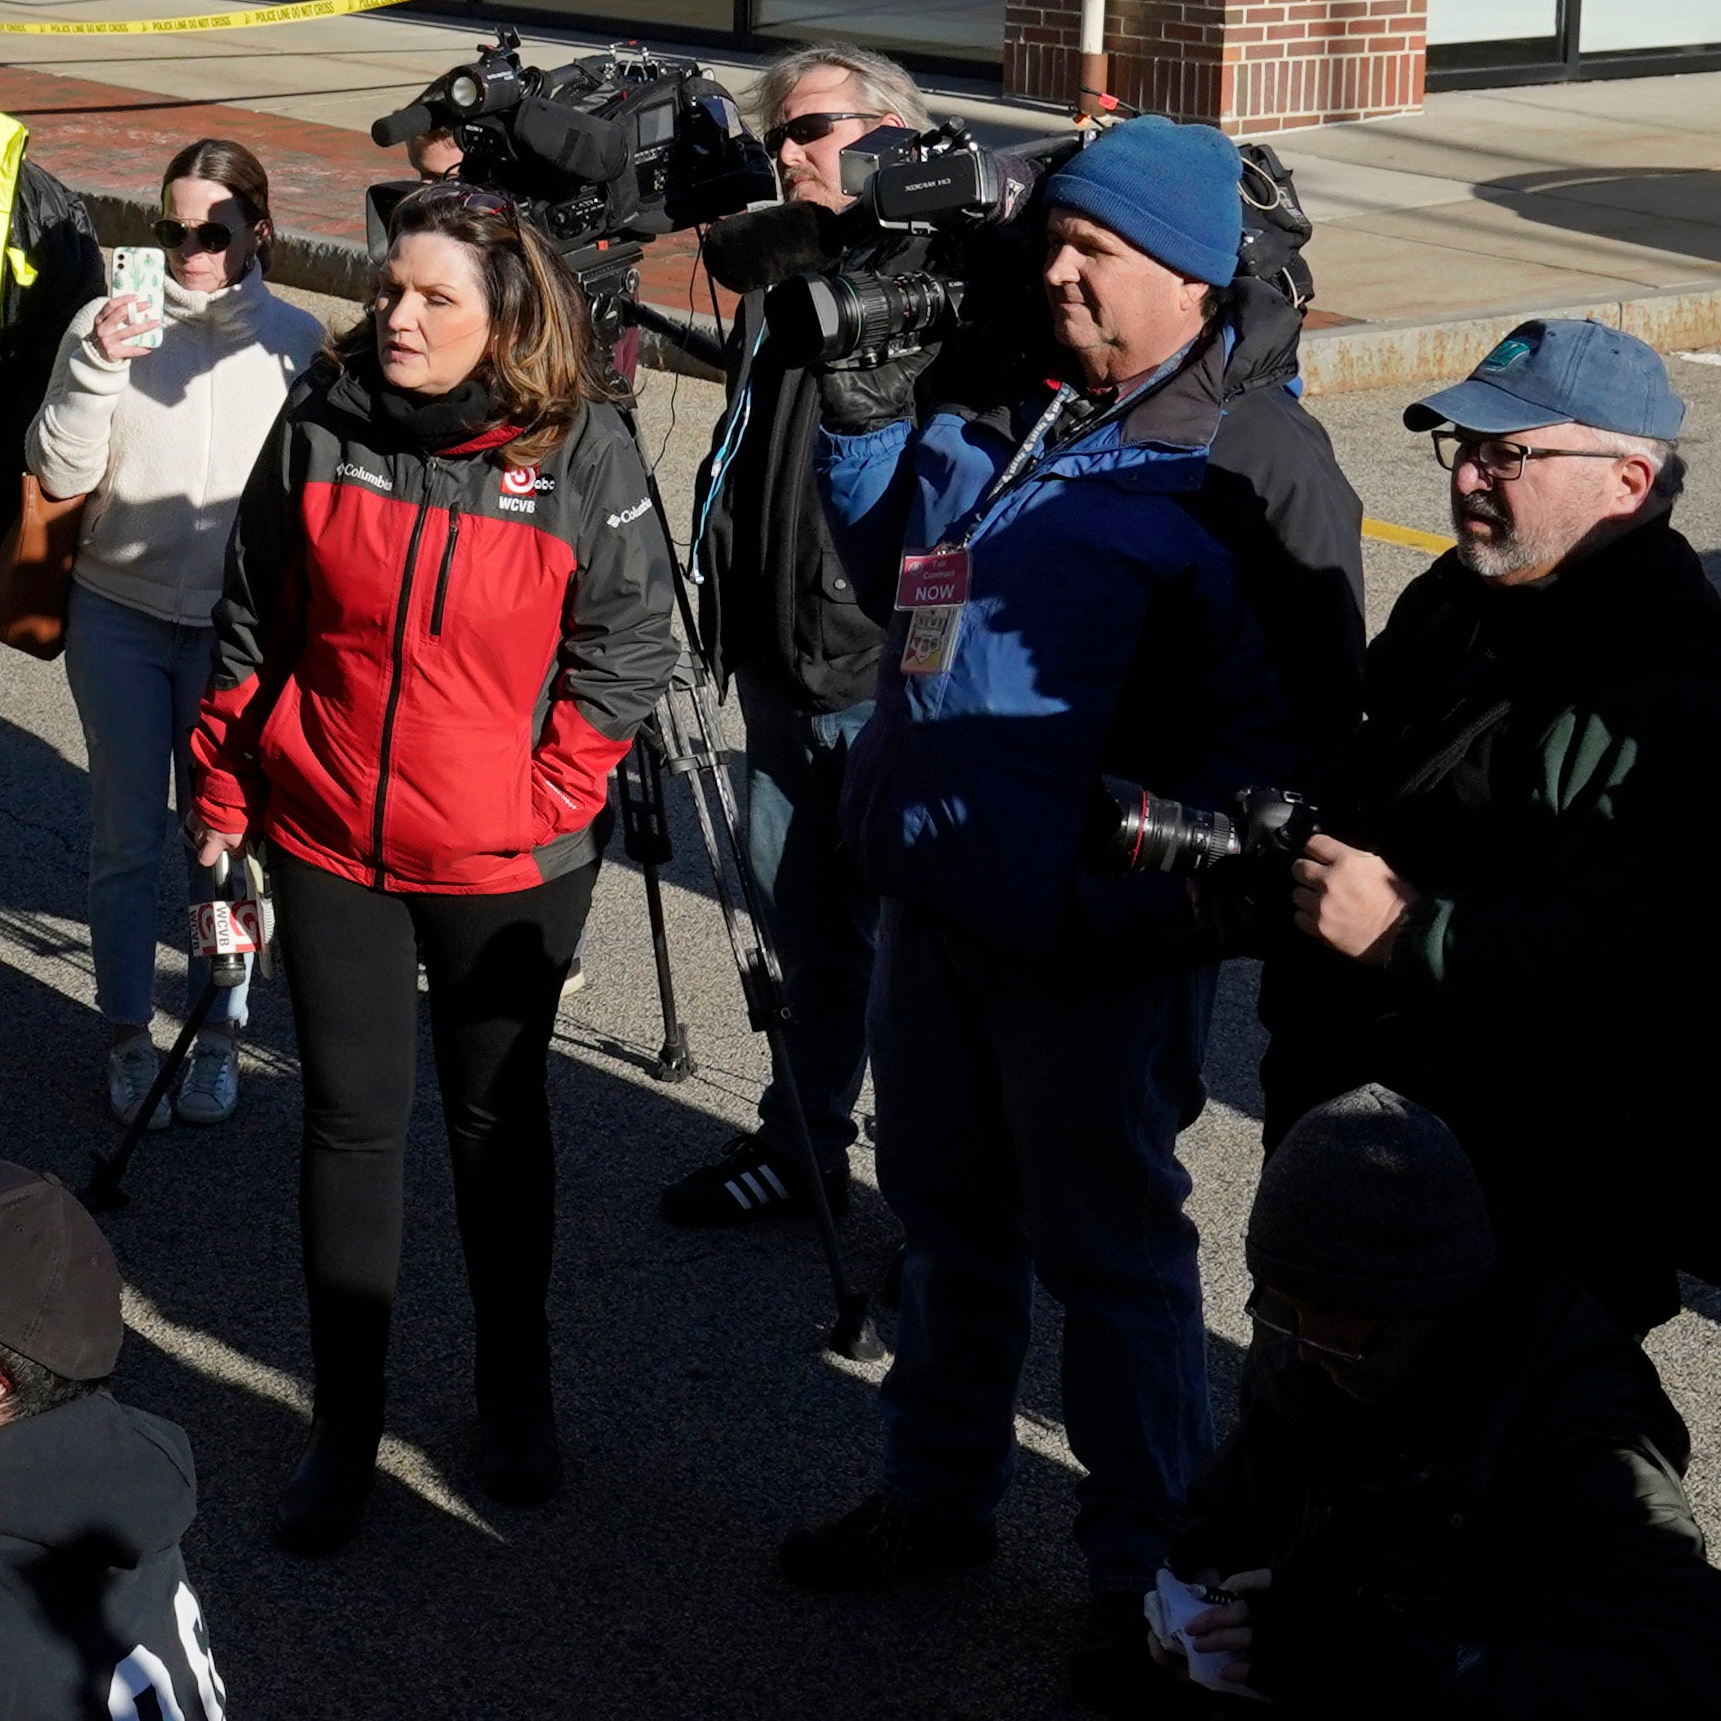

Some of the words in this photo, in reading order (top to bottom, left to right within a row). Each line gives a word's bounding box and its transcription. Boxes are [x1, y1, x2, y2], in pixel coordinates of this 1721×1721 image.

[255, 10, 276, 22] POLICE
[277, 7, 290, 20] LINE
[291, 5, 300, 17] DO
[301, 3, 314, 16] NOT
[314, 1, 334, 14] CROSS
[152, 21, 173, 31] POLICE
[174, 20, 187, 30] LINE
[188, 19, 197, 29] DO
[198, 17, 210, 28] NOT
[210, 16, 231, 27] CROSS
[344, 463, 393, 492] Columbia
[533, 477, 556, 491] abc
[498, 495, 536, 514] WCVB
[915, 584, 955, 601] NOW
[216, 906, 230, 946] WCVB
